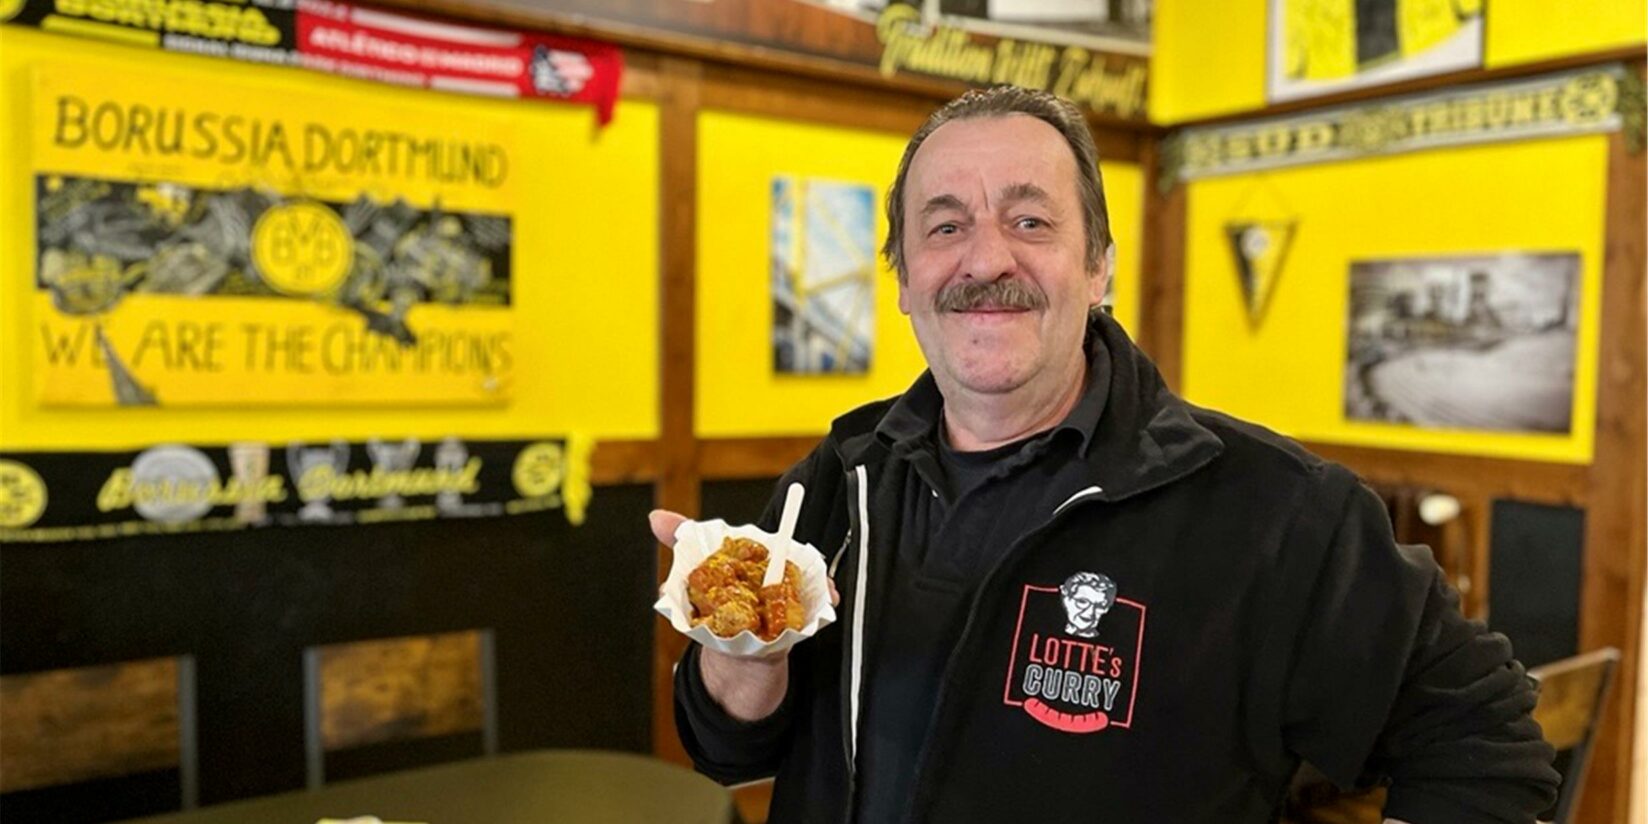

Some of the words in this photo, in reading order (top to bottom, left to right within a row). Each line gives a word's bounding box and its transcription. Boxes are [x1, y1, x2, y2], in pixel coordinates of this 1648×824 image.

[53, 95, 294, 171] BORUSSIA
[302, 123, 509, 188] DORTMUND
[131, 319, 224, 373] ARE
[241, 322, 318, 374] THE
[1022, 663, 1121, 711] CURRY
